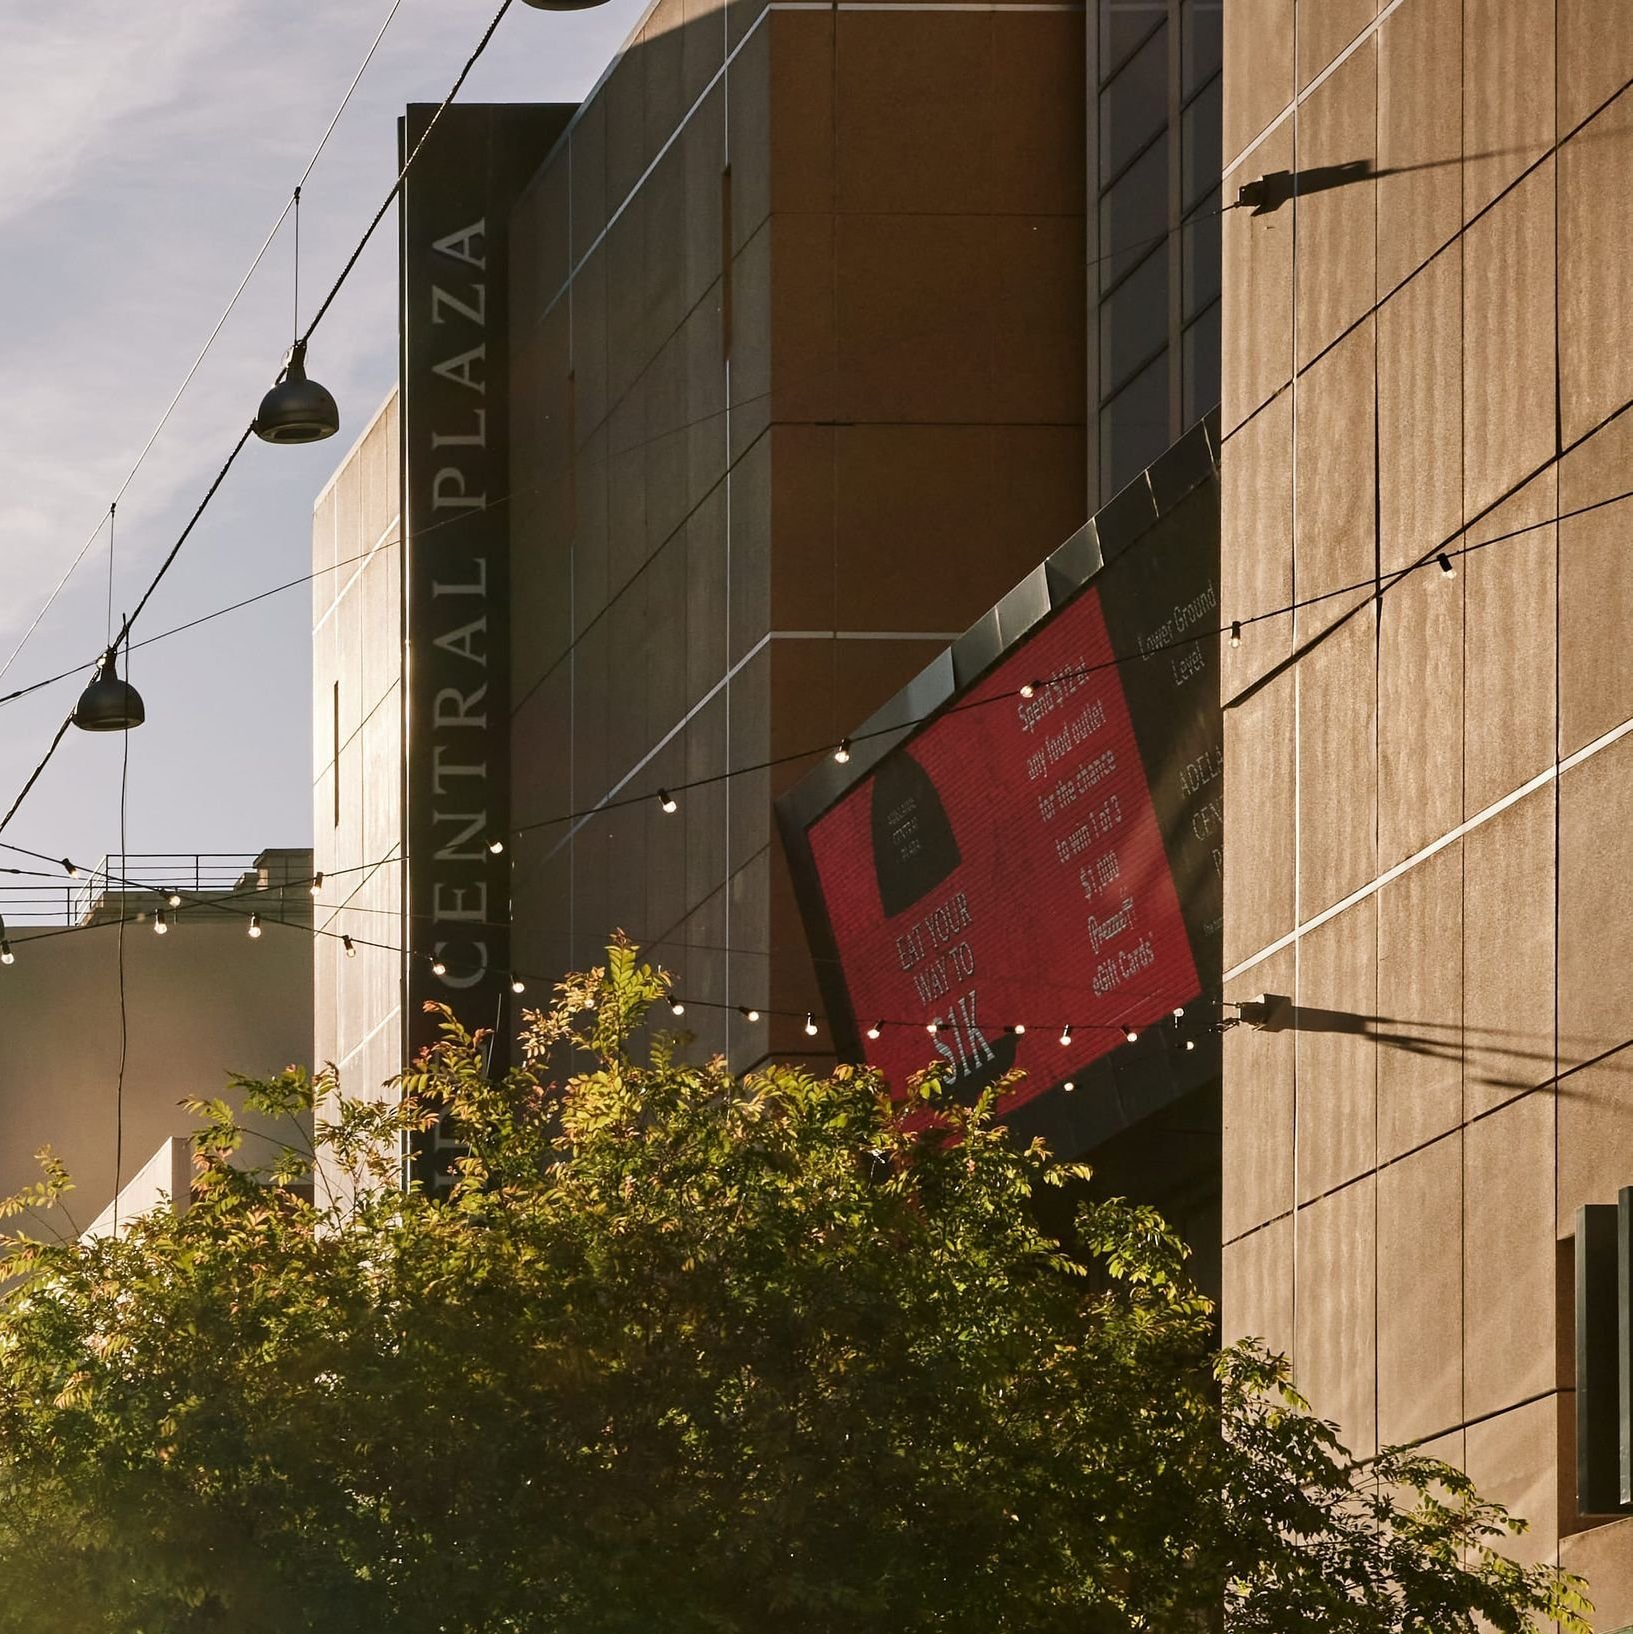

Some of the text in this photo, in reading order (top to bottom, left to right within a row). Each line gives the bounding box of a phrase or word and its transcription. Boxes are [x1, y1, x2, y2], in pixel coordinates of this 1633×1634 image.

[431, 216, 488, 991] CENTRAL PLAZA
[1137, 579, 1217, 661] Lower Ground
[1171, 640, 1205, 686] Level
[1017, 685, 1054, 734] Spend
[1044, 721, 1072, 764] food
[1072, 697, 1107, 744] outlet
[1179, 744, 1223, 799] ADELA
[895, 892, 973, 971] EAT YOUR
[913, 941, 975, 1006] WAY TO
